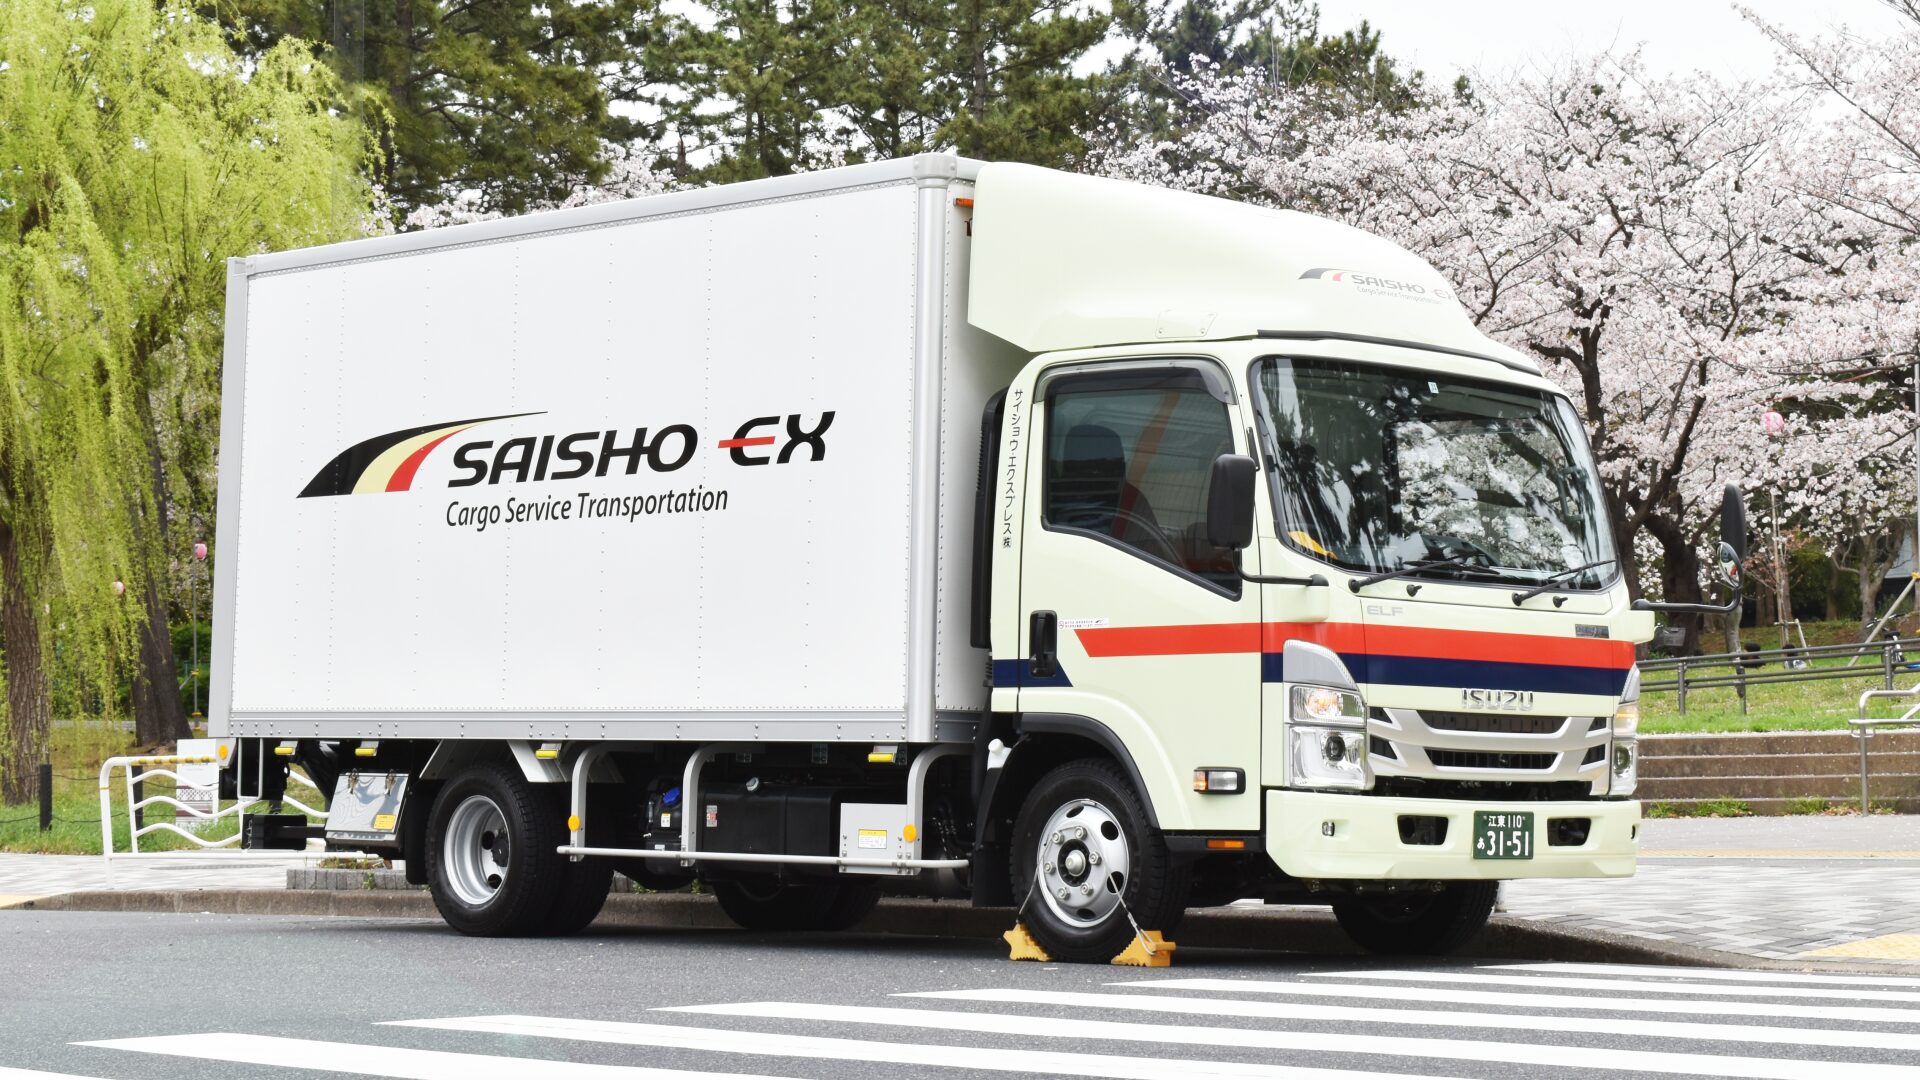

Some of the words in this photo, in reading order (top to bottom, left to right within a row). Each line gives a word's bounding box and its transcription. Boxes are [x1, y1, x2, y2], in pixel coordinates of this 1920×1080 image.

[1351, 274, 1426, 294] SAISHO
[447, 423, 699, 488] SAISHO
[717, 410, 836, 467] EX
[446, 500, 501, 532] Cargo
[504, 494, 572, 524] Service
[577, 484, 729, 523] Transportation
[1366, 605, 1403, 617] ELF
[1461, 688, 1534, 711] ISUZU
[1488, 815, 1506, 828] 江東
[1508, 815, 1522, 828] 110
